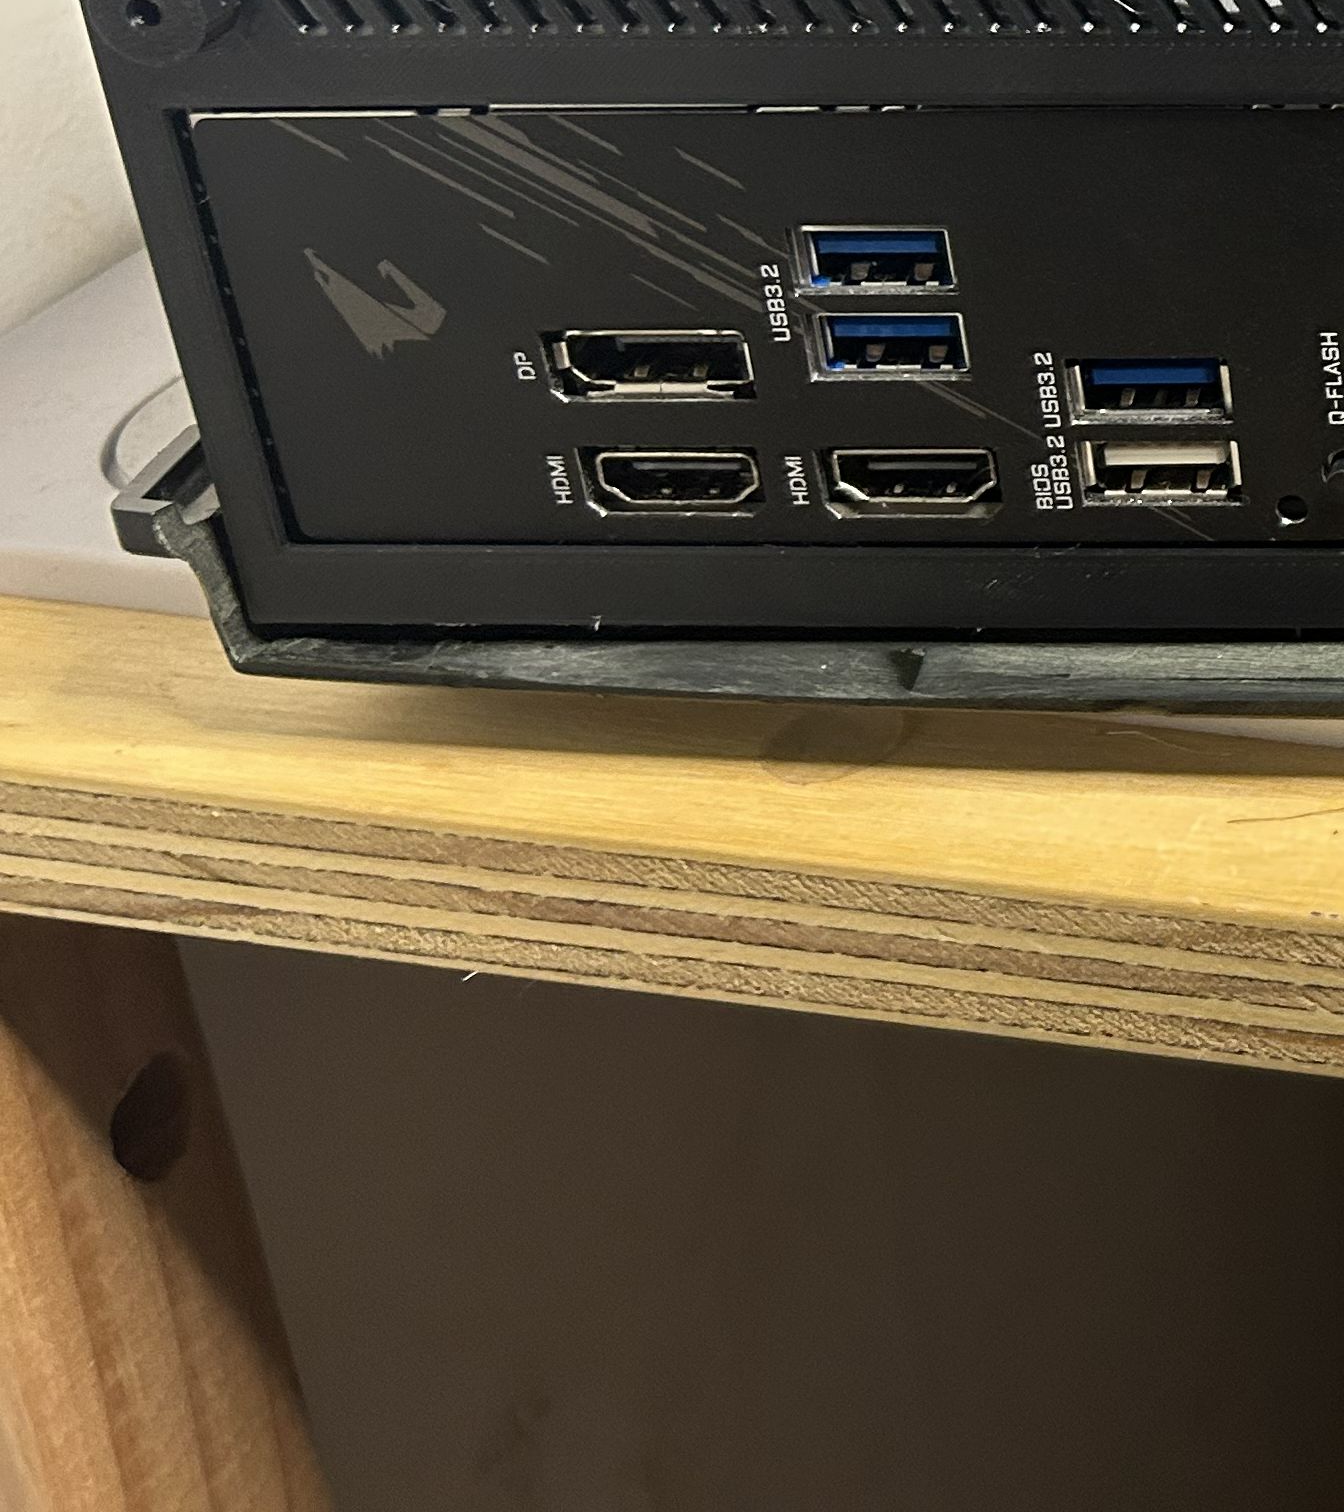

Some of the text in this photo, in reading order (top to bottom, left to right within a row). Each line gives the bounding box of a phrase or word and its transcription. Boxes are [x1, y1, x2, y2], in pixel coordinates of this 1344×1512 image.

[759, 263, 792, 343] USB3.2
[513, 351, 537, 381] DP
[1033, 351, 1062, 429] USB3.2
[546, 454, 574, 505] HDMI
[784, 455, 810, 506] HDMI
[1030, 463, 1053, 511] BIOS
[1045, 435, 1074, 510] USB3.2
